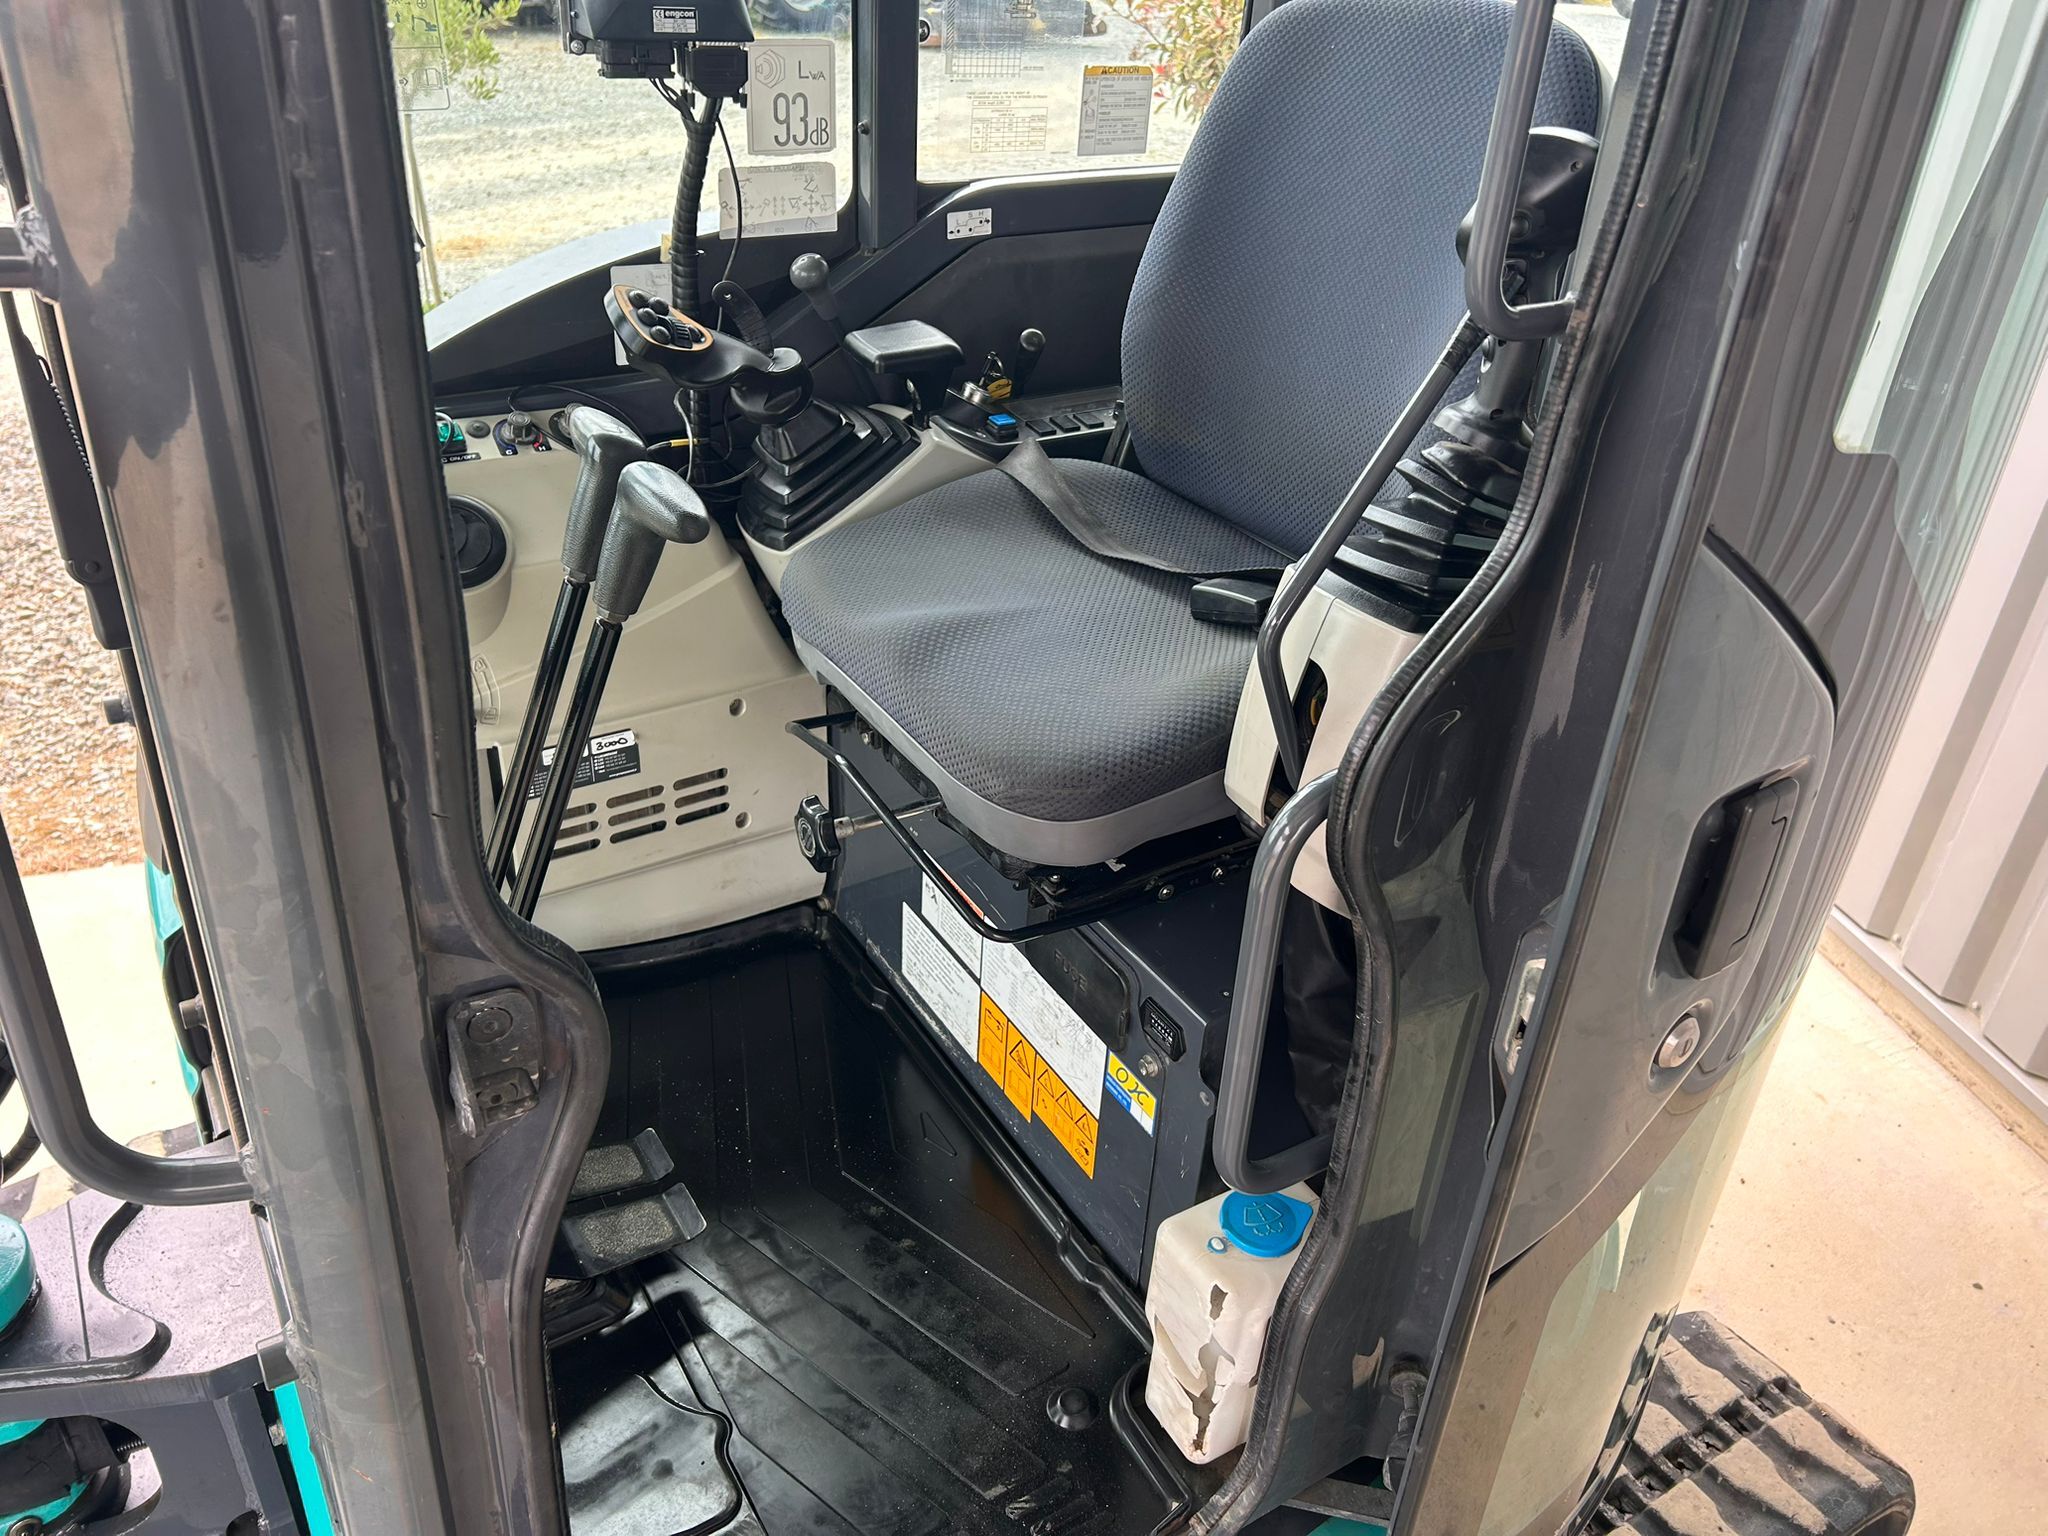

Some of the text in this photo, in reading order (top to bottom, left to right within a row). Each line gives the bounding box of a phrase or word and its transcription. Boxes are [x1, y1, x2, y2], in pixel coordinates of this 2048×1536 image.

[665, 10, 695, 19] engcon
[1108, 66, 1140, 75] CAUTION
[449, 454, 476, 462] ON/OFF
[595, 737, 629, 752] 3000
[1054, 948, 1088, 992] FUSE
